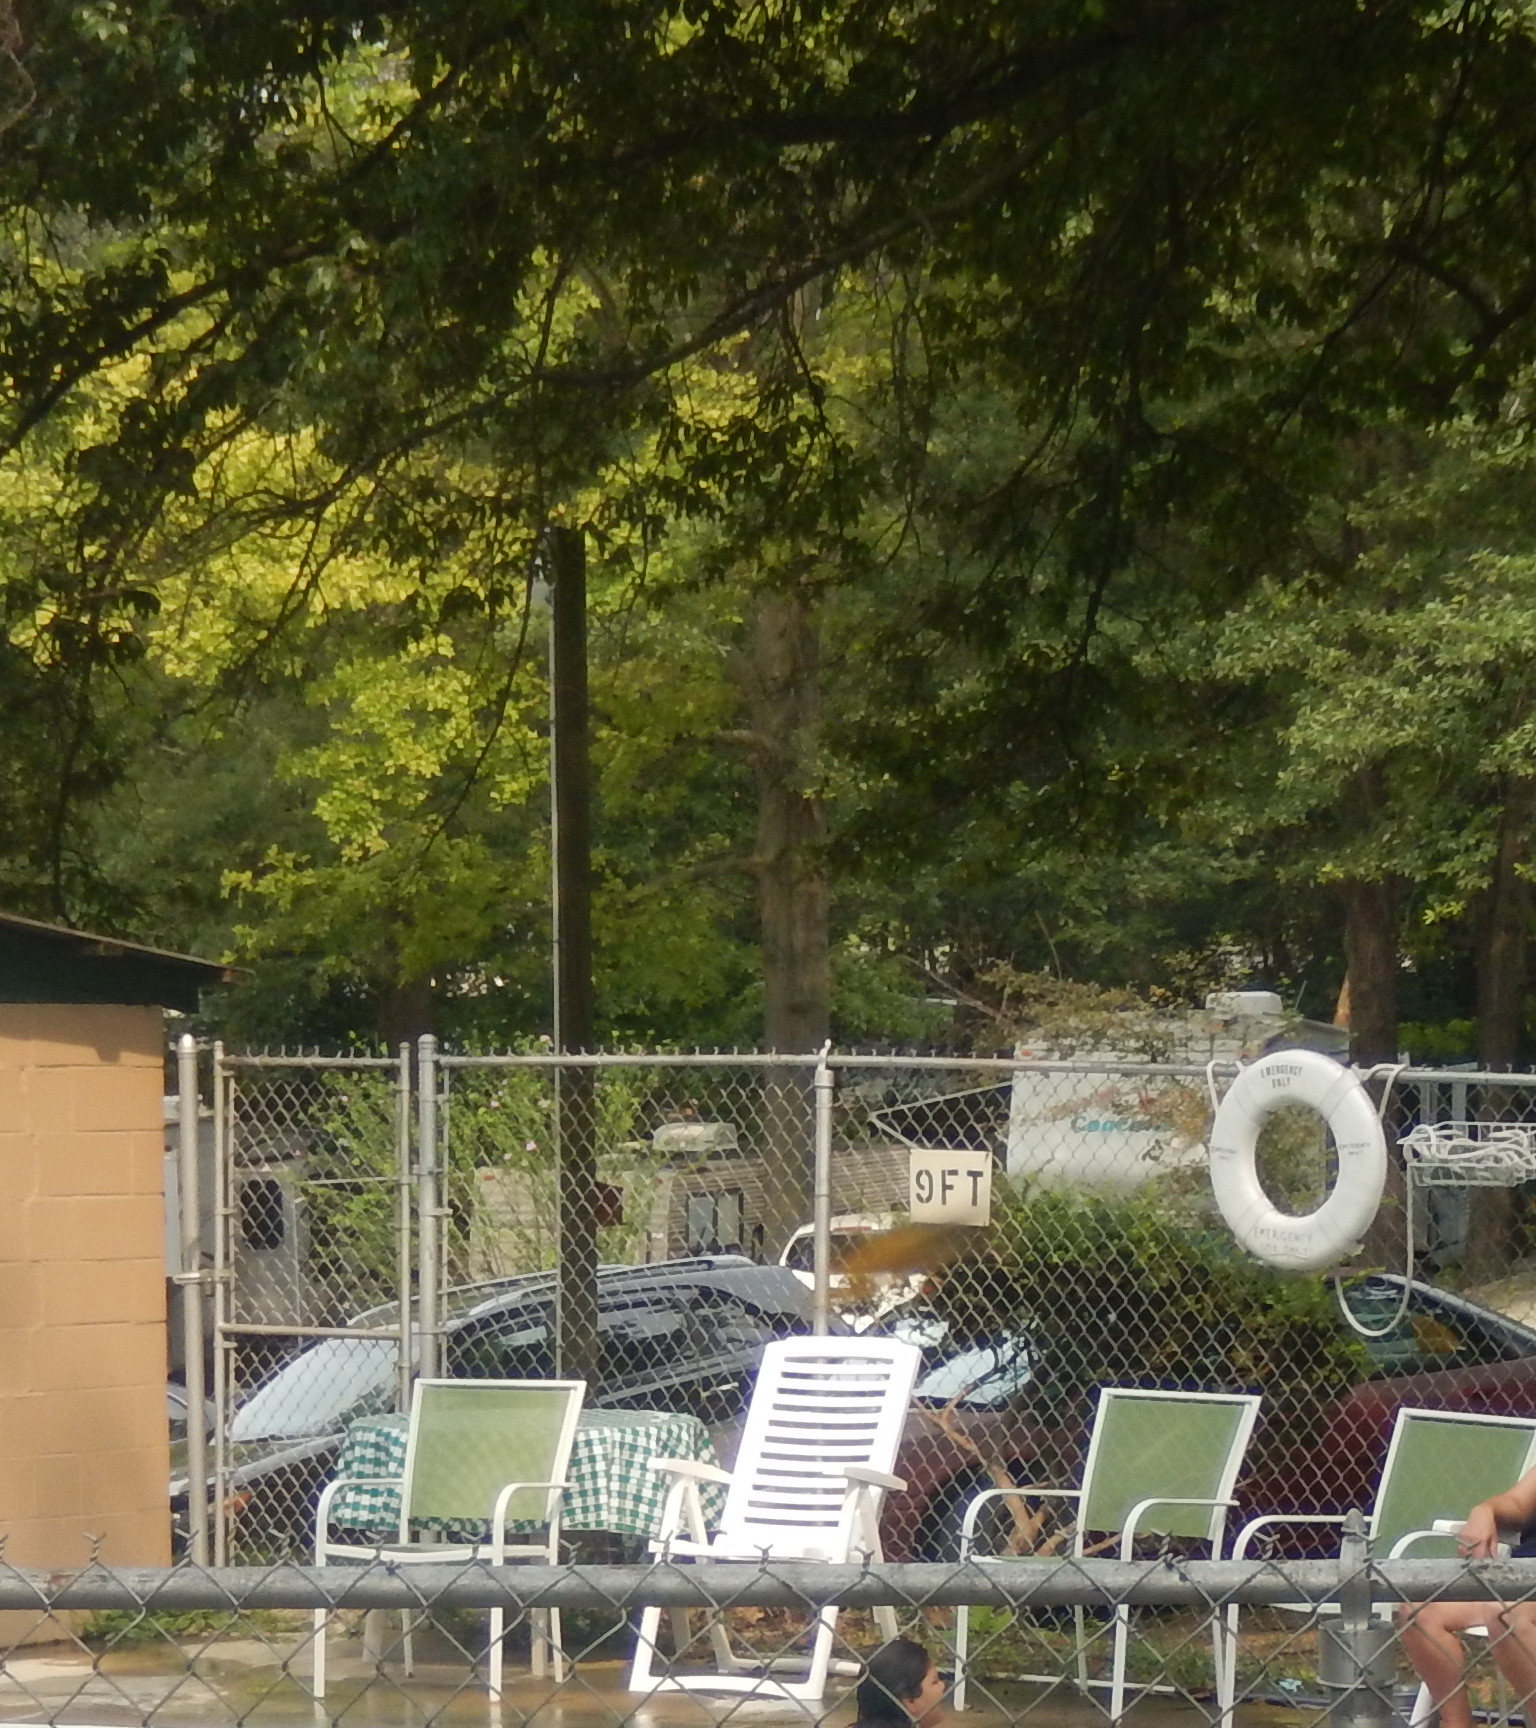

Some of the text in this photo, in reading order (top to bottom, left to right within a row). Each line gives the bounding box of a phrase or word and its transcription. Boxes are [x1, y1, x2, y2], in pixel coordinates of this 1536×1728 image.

[1260, 1064, 1303, 1078] EMERGENCY
[915, 1169, 984, 1206] 9FT
[1254, 1226, 1313, 1243] EMERGENCY
